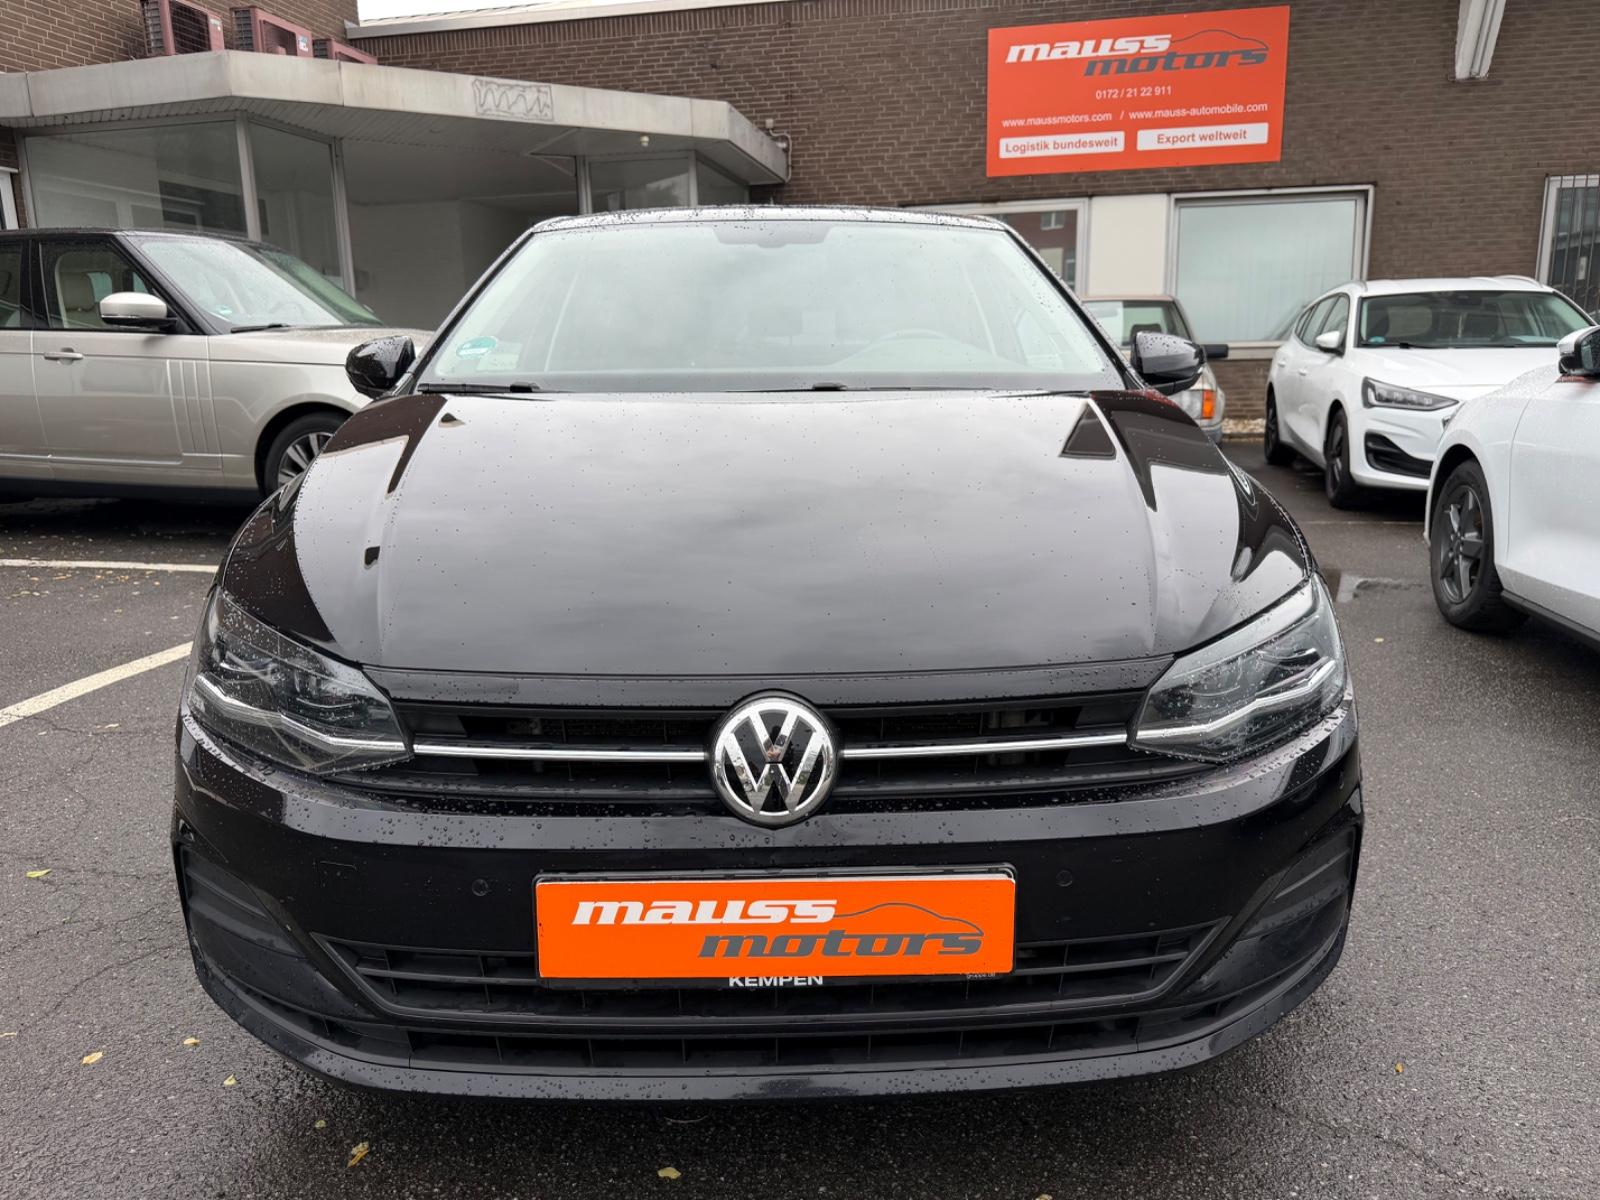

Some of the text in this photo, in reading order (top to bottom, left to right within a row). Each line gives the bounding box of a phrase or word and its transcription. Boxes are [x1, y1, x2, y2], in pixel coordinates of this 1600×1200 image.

[1005, 34, 1171, 63] mauss
[1084, 48, 1268, 76] motors
[1095, 88, 1118, 100] 0172
[1126, 87, 1137, 97] 21
[1140, 86, 1152, 96] 22
[1154, 85, 1172, 95] 911
[1002, 112, 1112, 127] www.maussmotors.com
[1129, 103, 1268, 119] www.mauss-automobile.com
[1005, 137, 1119, 154] Logistik bundesweit
[1157, 129, 1247, 145] Export weltweit
[572, 899, 838, 925] mauss
[697, 929, 984, 958] motors
[729, 976, 823, 987] KEMPEN
